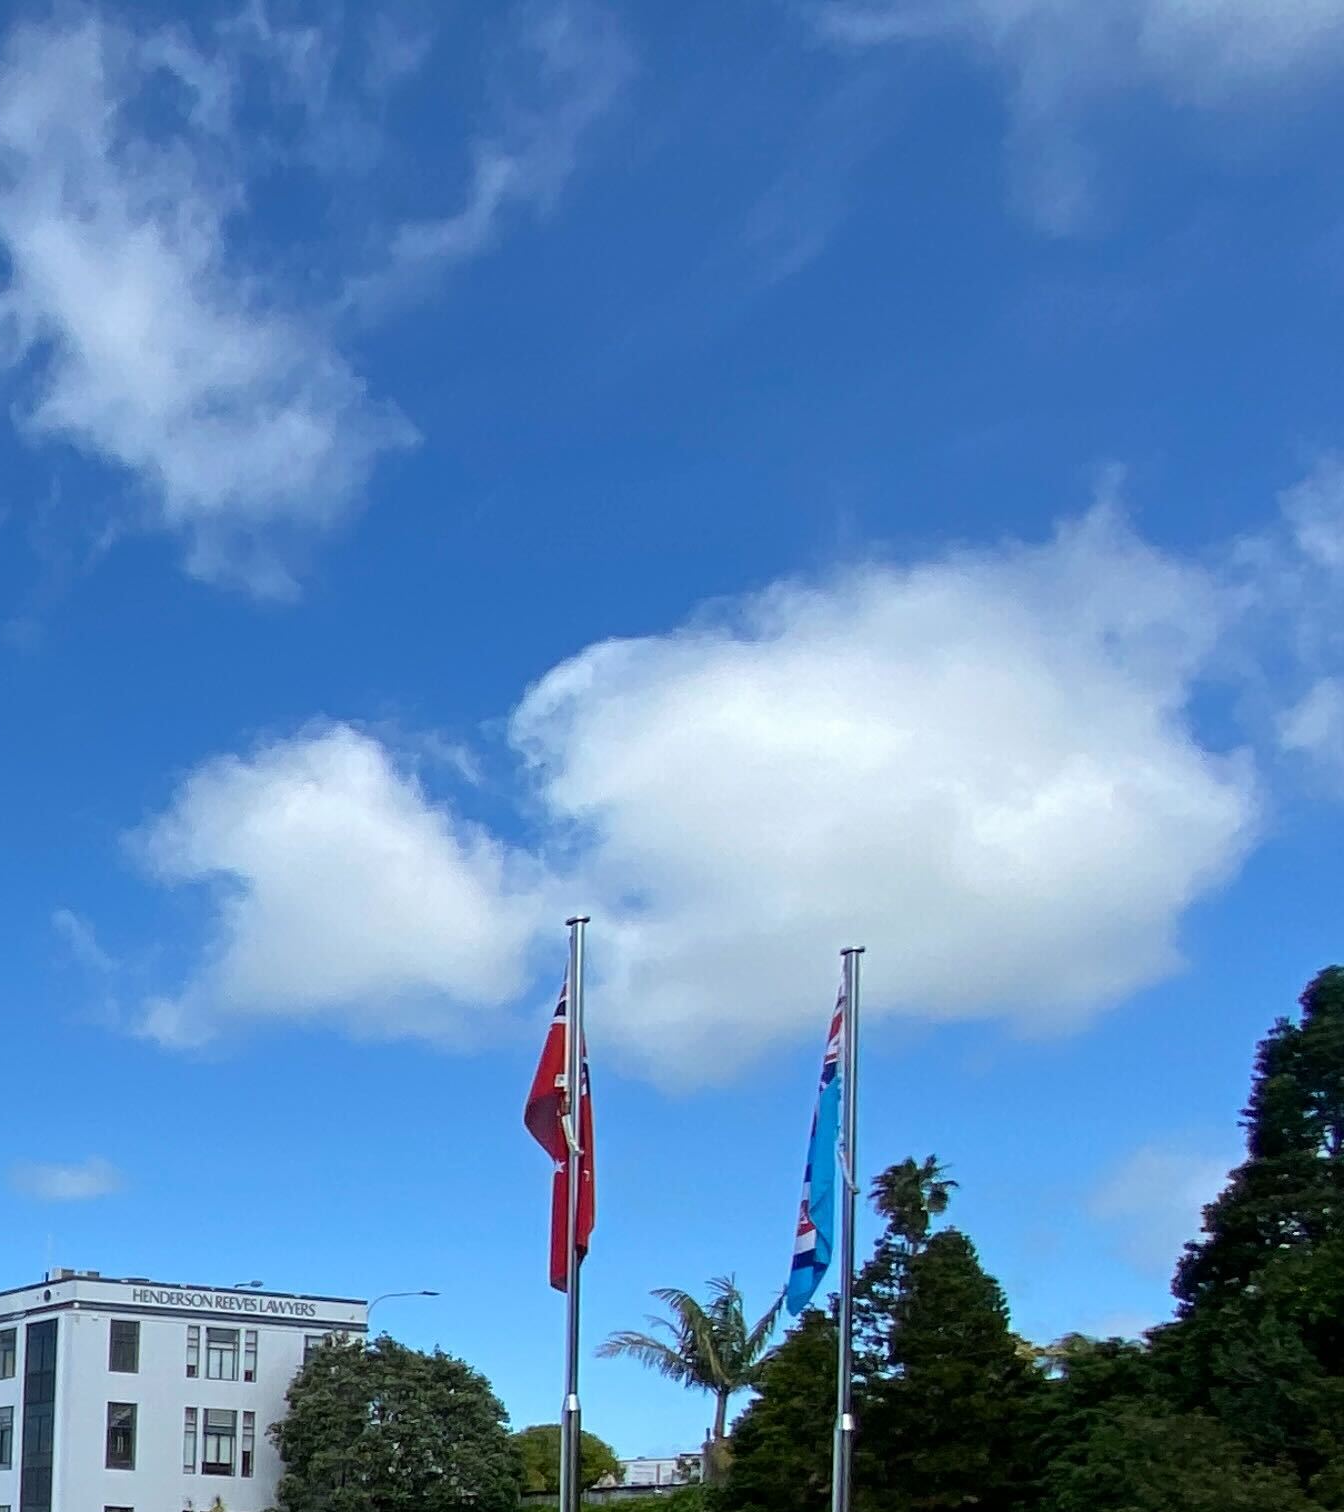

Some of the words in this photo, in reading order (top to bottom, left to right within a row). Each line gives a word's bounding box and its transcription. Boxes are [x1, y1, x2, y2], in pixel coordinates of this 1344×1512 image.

[132, 1288, 212, 1309] HENDERSON
[215, 1295, 257, 1312] REEVES
[259, 1299, 316, 1317] LAWYERS
